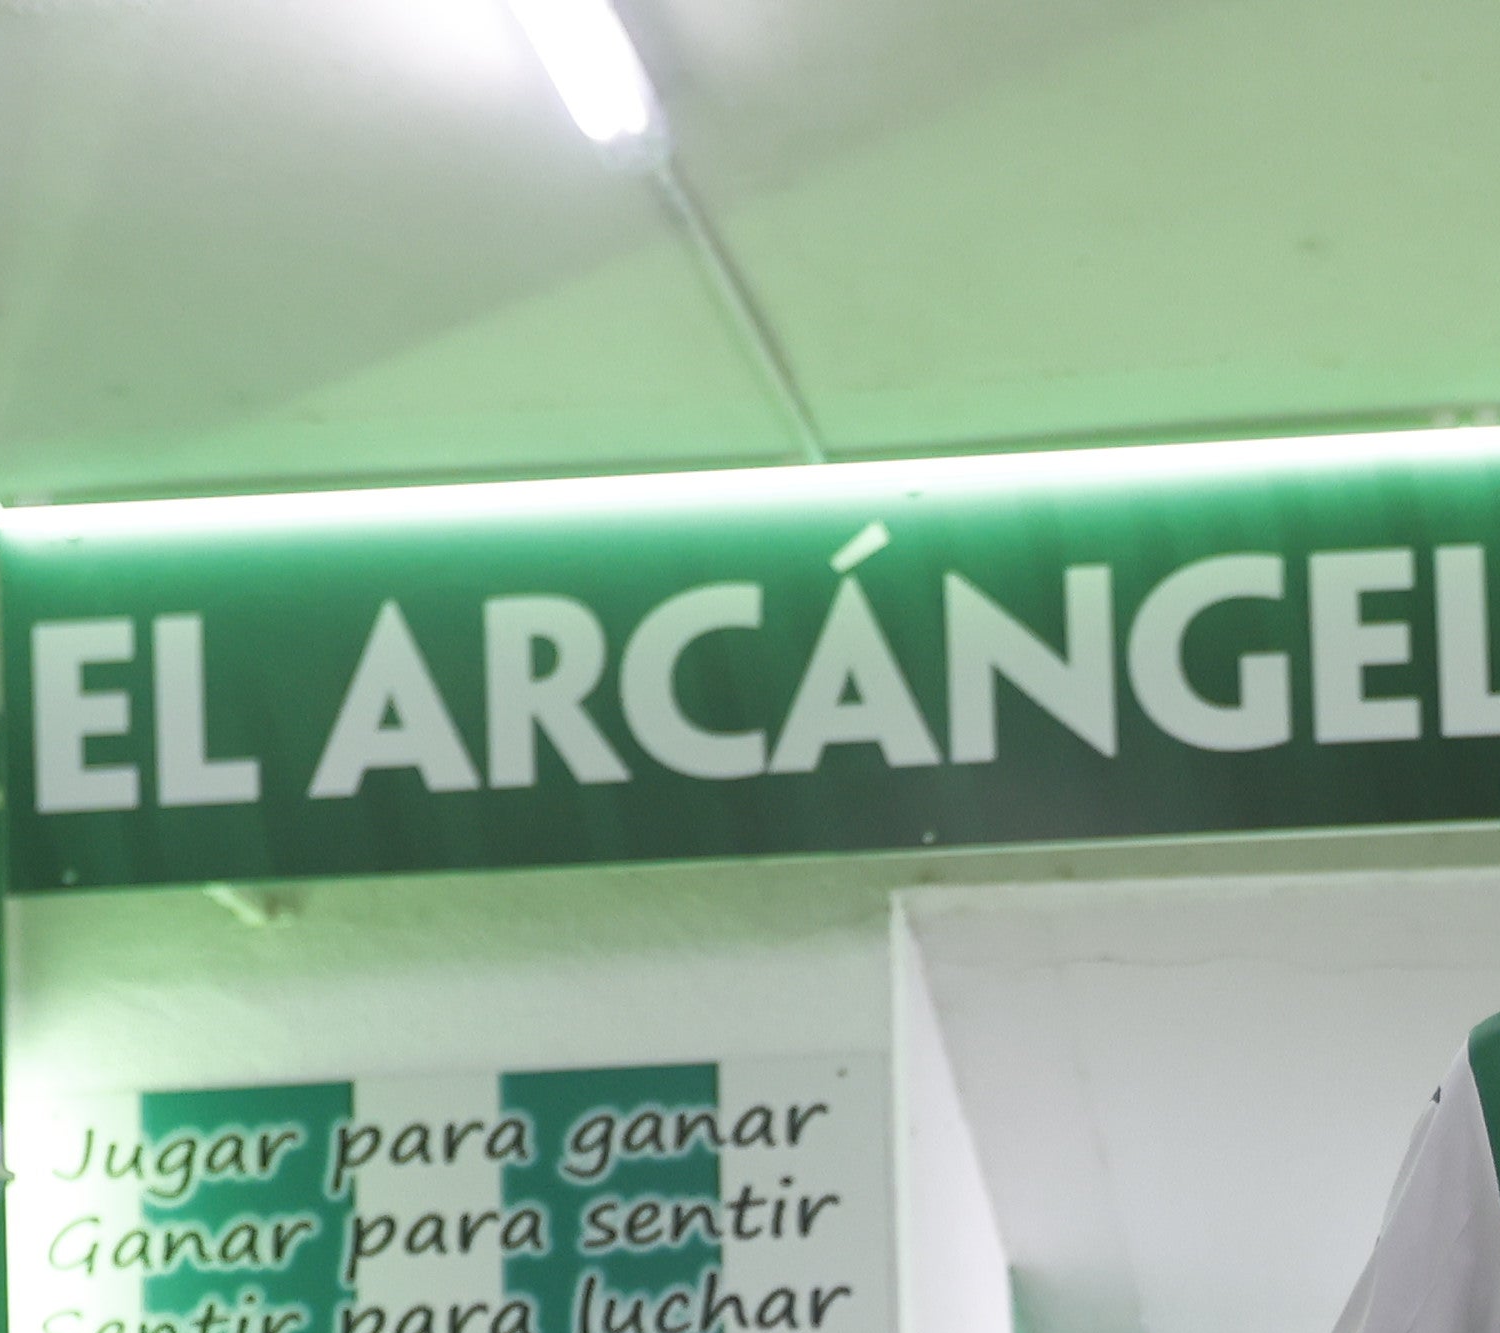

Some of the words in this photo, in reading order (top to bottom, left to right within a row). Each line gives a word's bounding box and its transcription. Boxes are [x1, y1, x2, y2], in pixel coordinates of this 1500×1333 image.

[30, 612, 262, 816] EL
[53, 1121, 300, 1200] Jugar
[329, 1111, 531, 1195] para
[560, 1098, 829, 1178] ganar
[47, 1213, 312, 1274] Ganar
[345, 1202, 546, 1280] para
[581, 1175, 841, 1250] sentir
